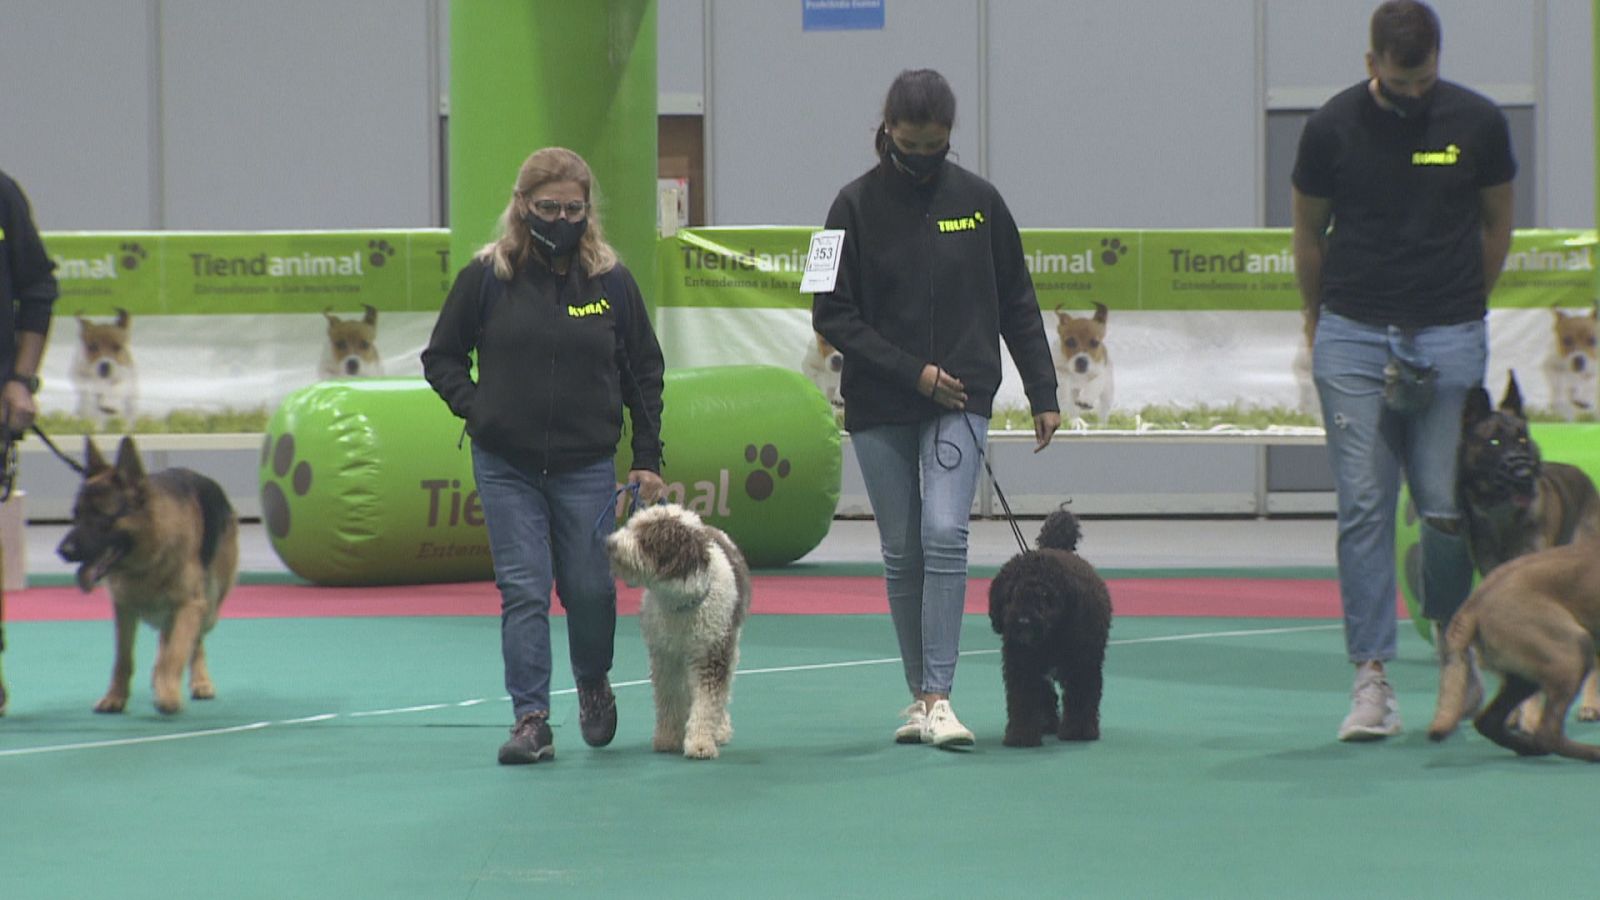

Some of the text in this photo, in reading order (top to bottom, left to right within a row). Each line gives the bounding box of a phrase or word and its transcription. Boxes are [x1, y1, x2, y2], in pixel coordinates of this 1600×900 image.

[190, 250, 363, 277] Tiendanimal
[681, 245, 808, 273] Tiendani
[813, 247, 834, 260] 353
[1169, 247, 1296, 273] Tiendani
